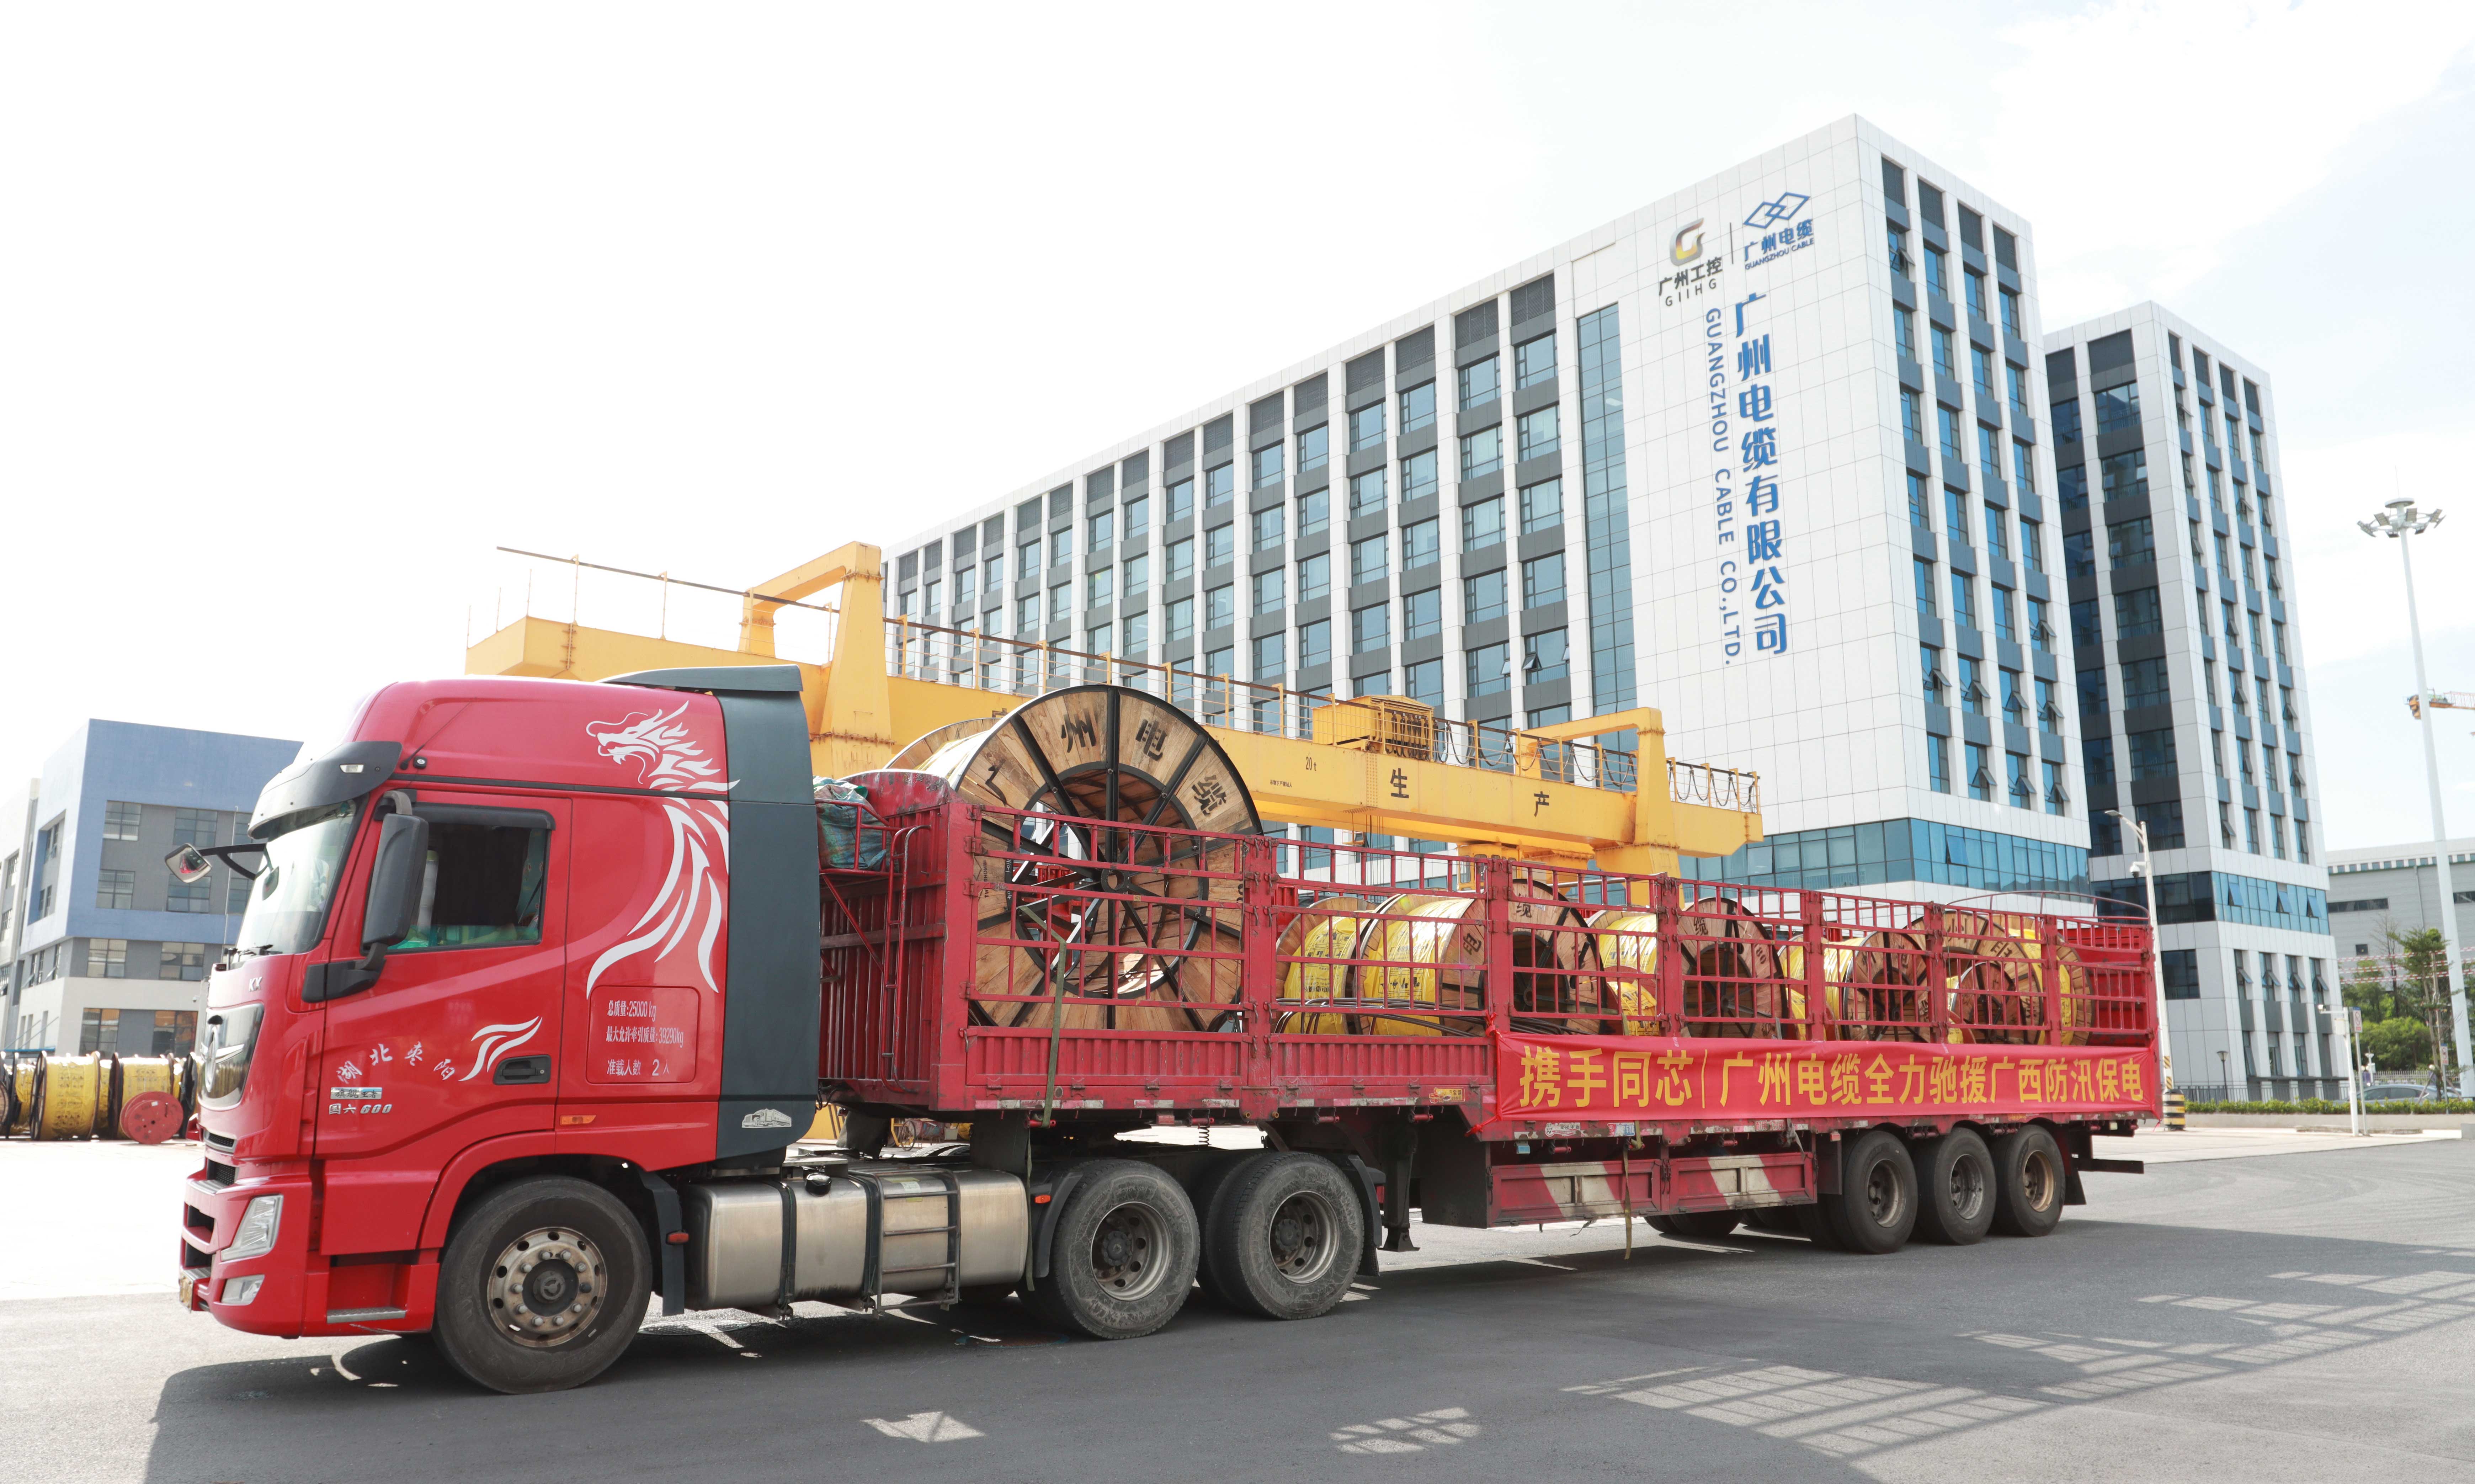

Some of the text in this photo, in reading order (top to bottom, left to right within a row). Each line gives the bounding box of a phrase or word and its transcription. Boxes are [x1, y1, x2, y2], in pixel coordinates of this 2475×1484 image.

[1744, 219, 1813, 261] 广州电缆
[1745, 238, 1814, 270] GUANGZHOU CABLE
[1659, 256, 1723, 296] 广州工控
[1706, 308, 1729, 452] GUANGZHOU
[1735, 292, 1787, 655] 广州电缆有限公司
[1715, 468, 1734, 546] CABLE
[606, 1059, 642, 1076] 准载人数
[335, 1088, 378, 1099] 旗舰王者
